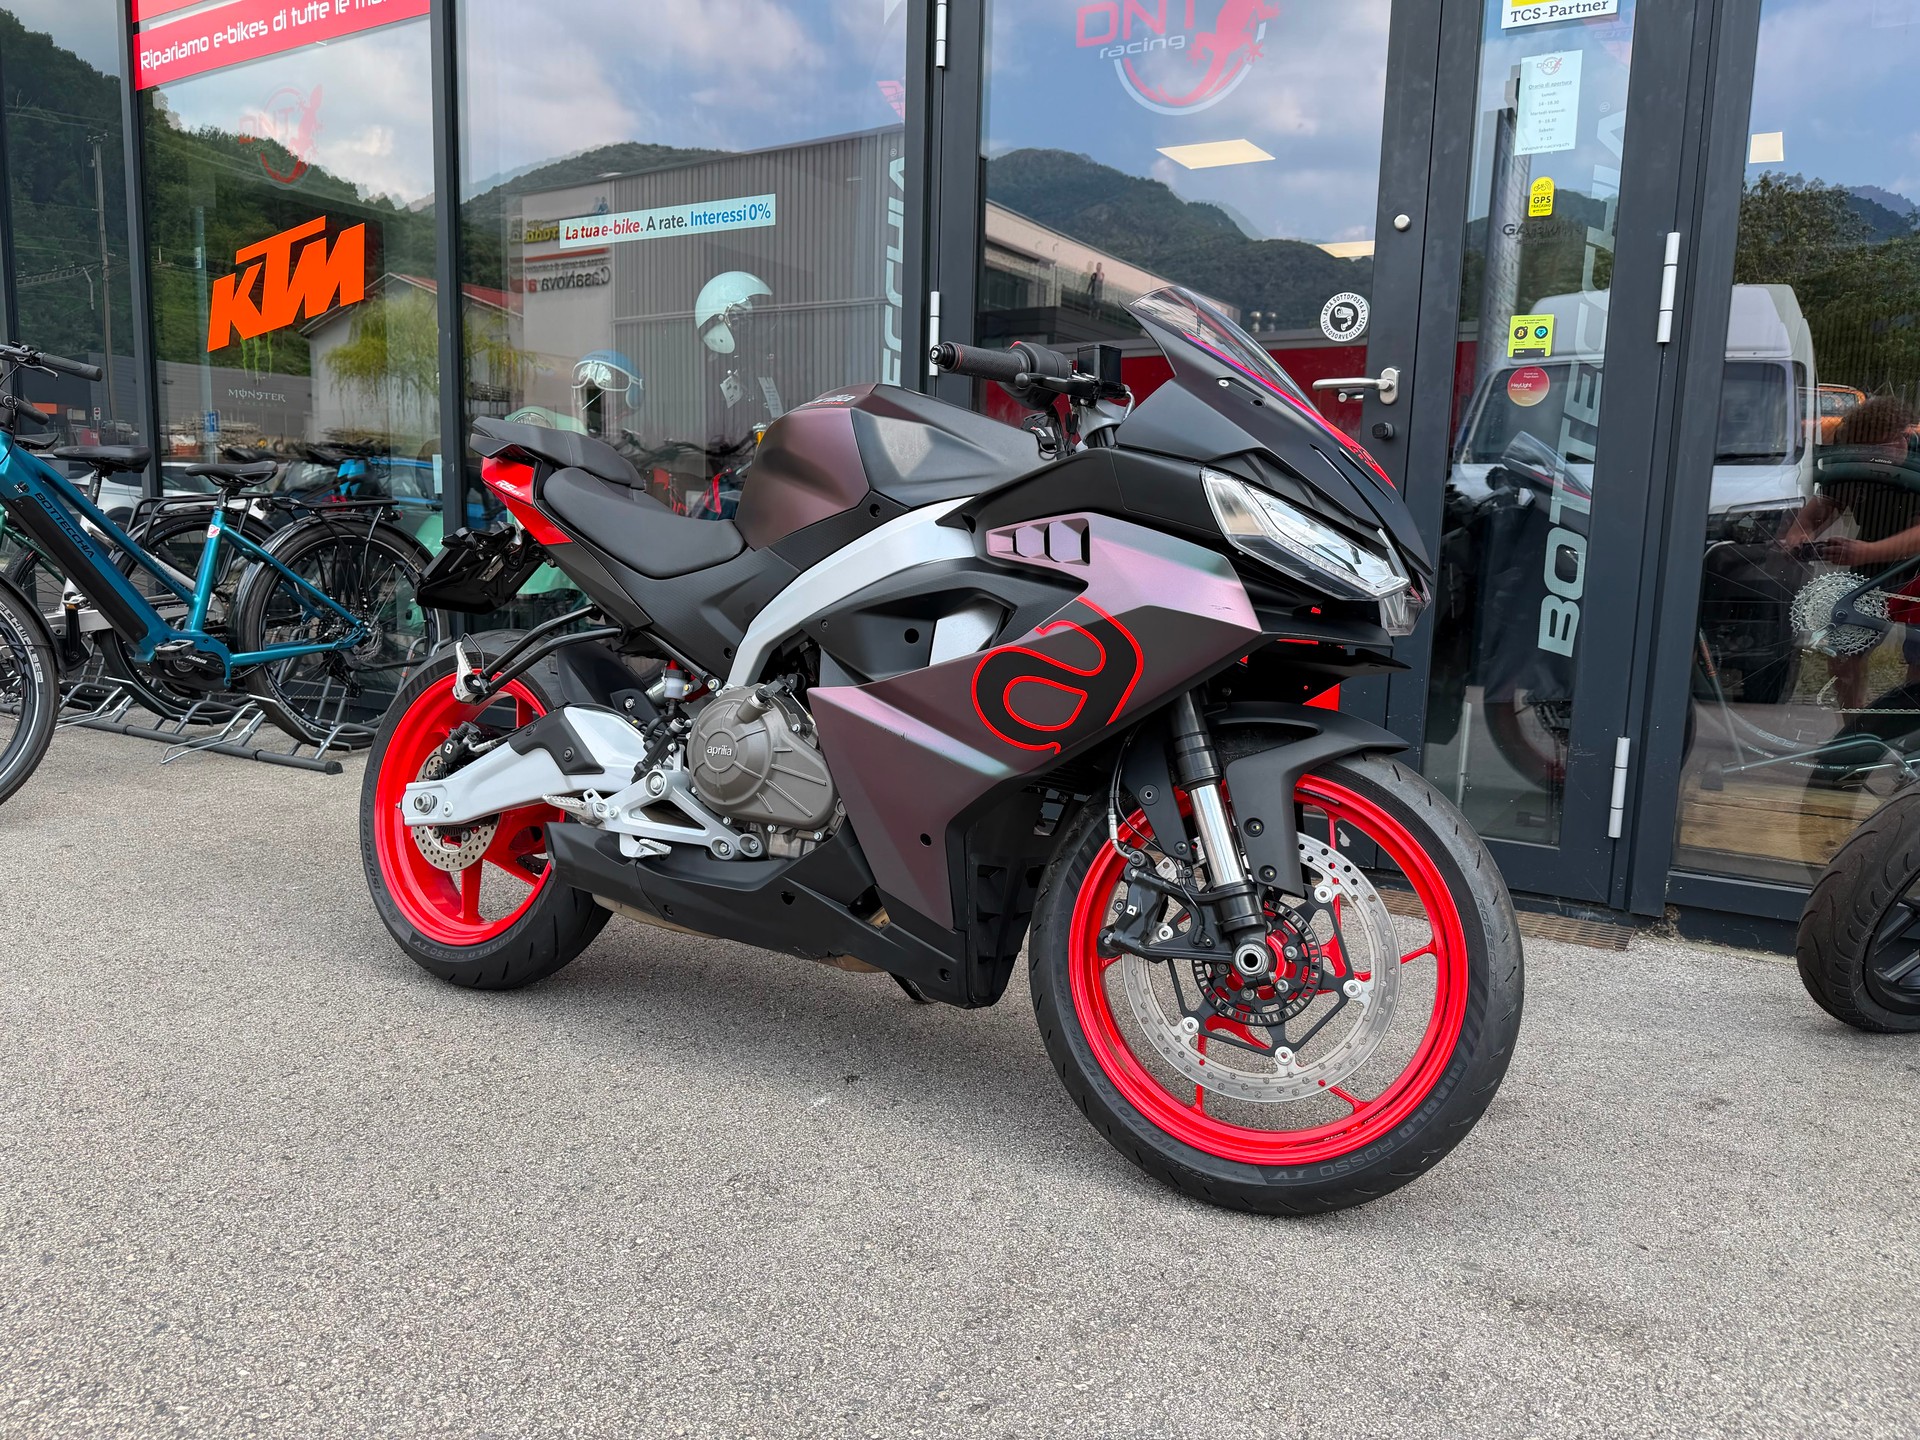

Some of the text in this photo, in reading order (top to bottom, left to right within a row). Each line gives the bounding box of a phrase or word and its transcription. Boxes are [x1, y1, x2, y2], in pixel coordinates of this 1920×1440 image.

[1510, 0, 1609, 23] TCS-Partner
[140, 34, 210, 71] Ripariamo
[213, 20, 268, 49] e-bikes
[273, 11, 287, 31] di
[292, 2, 330, 27] tutte
[1099, 34, 1186, 60] racing
[1533, 195, 1552, 204] GPS
[564, 225, 579, 241] La
[580, 225, 600, 239] tua
[601, 217, 644, 237] e-bike.
[645, 215, 657, 232] A
[658, 213, 688, 230] rate.
[689, 203, 747, 227] Interessi
[749, 202, 772, 222] 0%
[207, 215, 365, 352] KTM
[34, 491, 96, 559] BOTTECCHIA
[706, 744, 733, 757] aprilia
[1398, 1060, 1468, 1139] DIABLO
[1318, 1138, 1395, 1177] ROSSO
